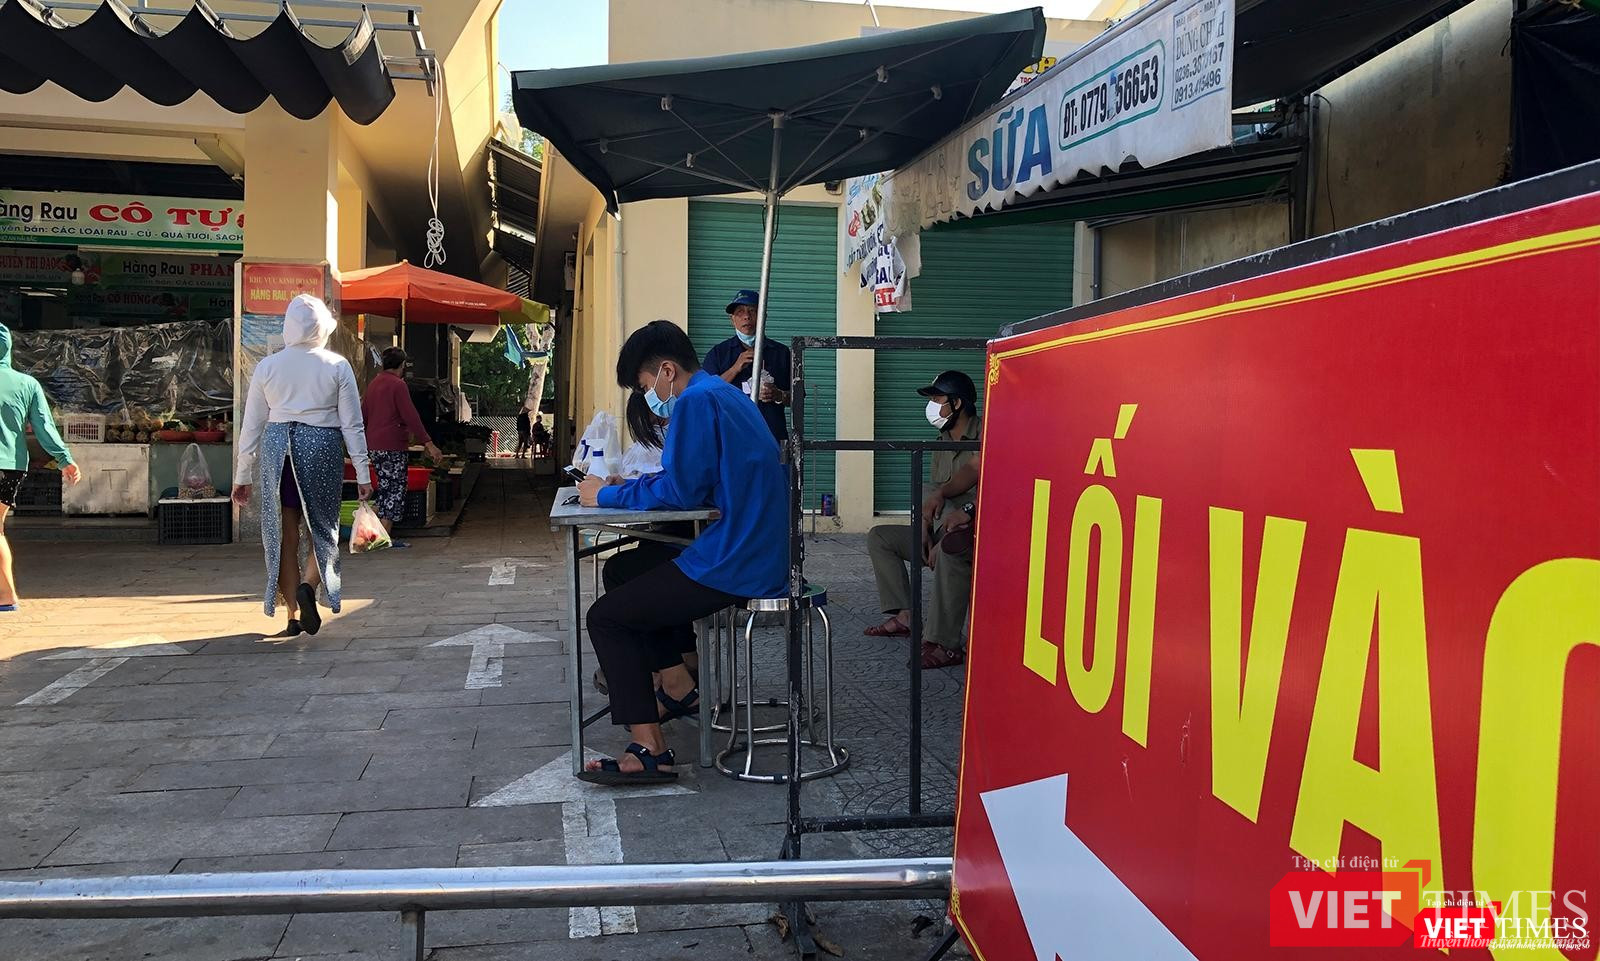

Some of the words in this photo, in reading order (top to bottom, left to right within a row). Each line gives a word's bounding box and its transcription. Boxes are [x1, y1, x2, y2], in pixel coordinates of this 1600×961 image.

[1063, 98, 1078, 139] ĐT:
[1080, 55, 1159, 131] 0779.56653
[967, 104, 1052, 200] SỮA
[40, 202, 78, 220] Rau
[89, 201, 153, 223] CÔ
[167, 207, 233, 231] TỰ
[51, 226, 76, 234] CÁC
[107, 229, 128, 237] RAU
[123, 259, 157, 278] Hàng
[161, 262, 184, 275] Rau
[1023, 403, 1163, 749] LỐI
